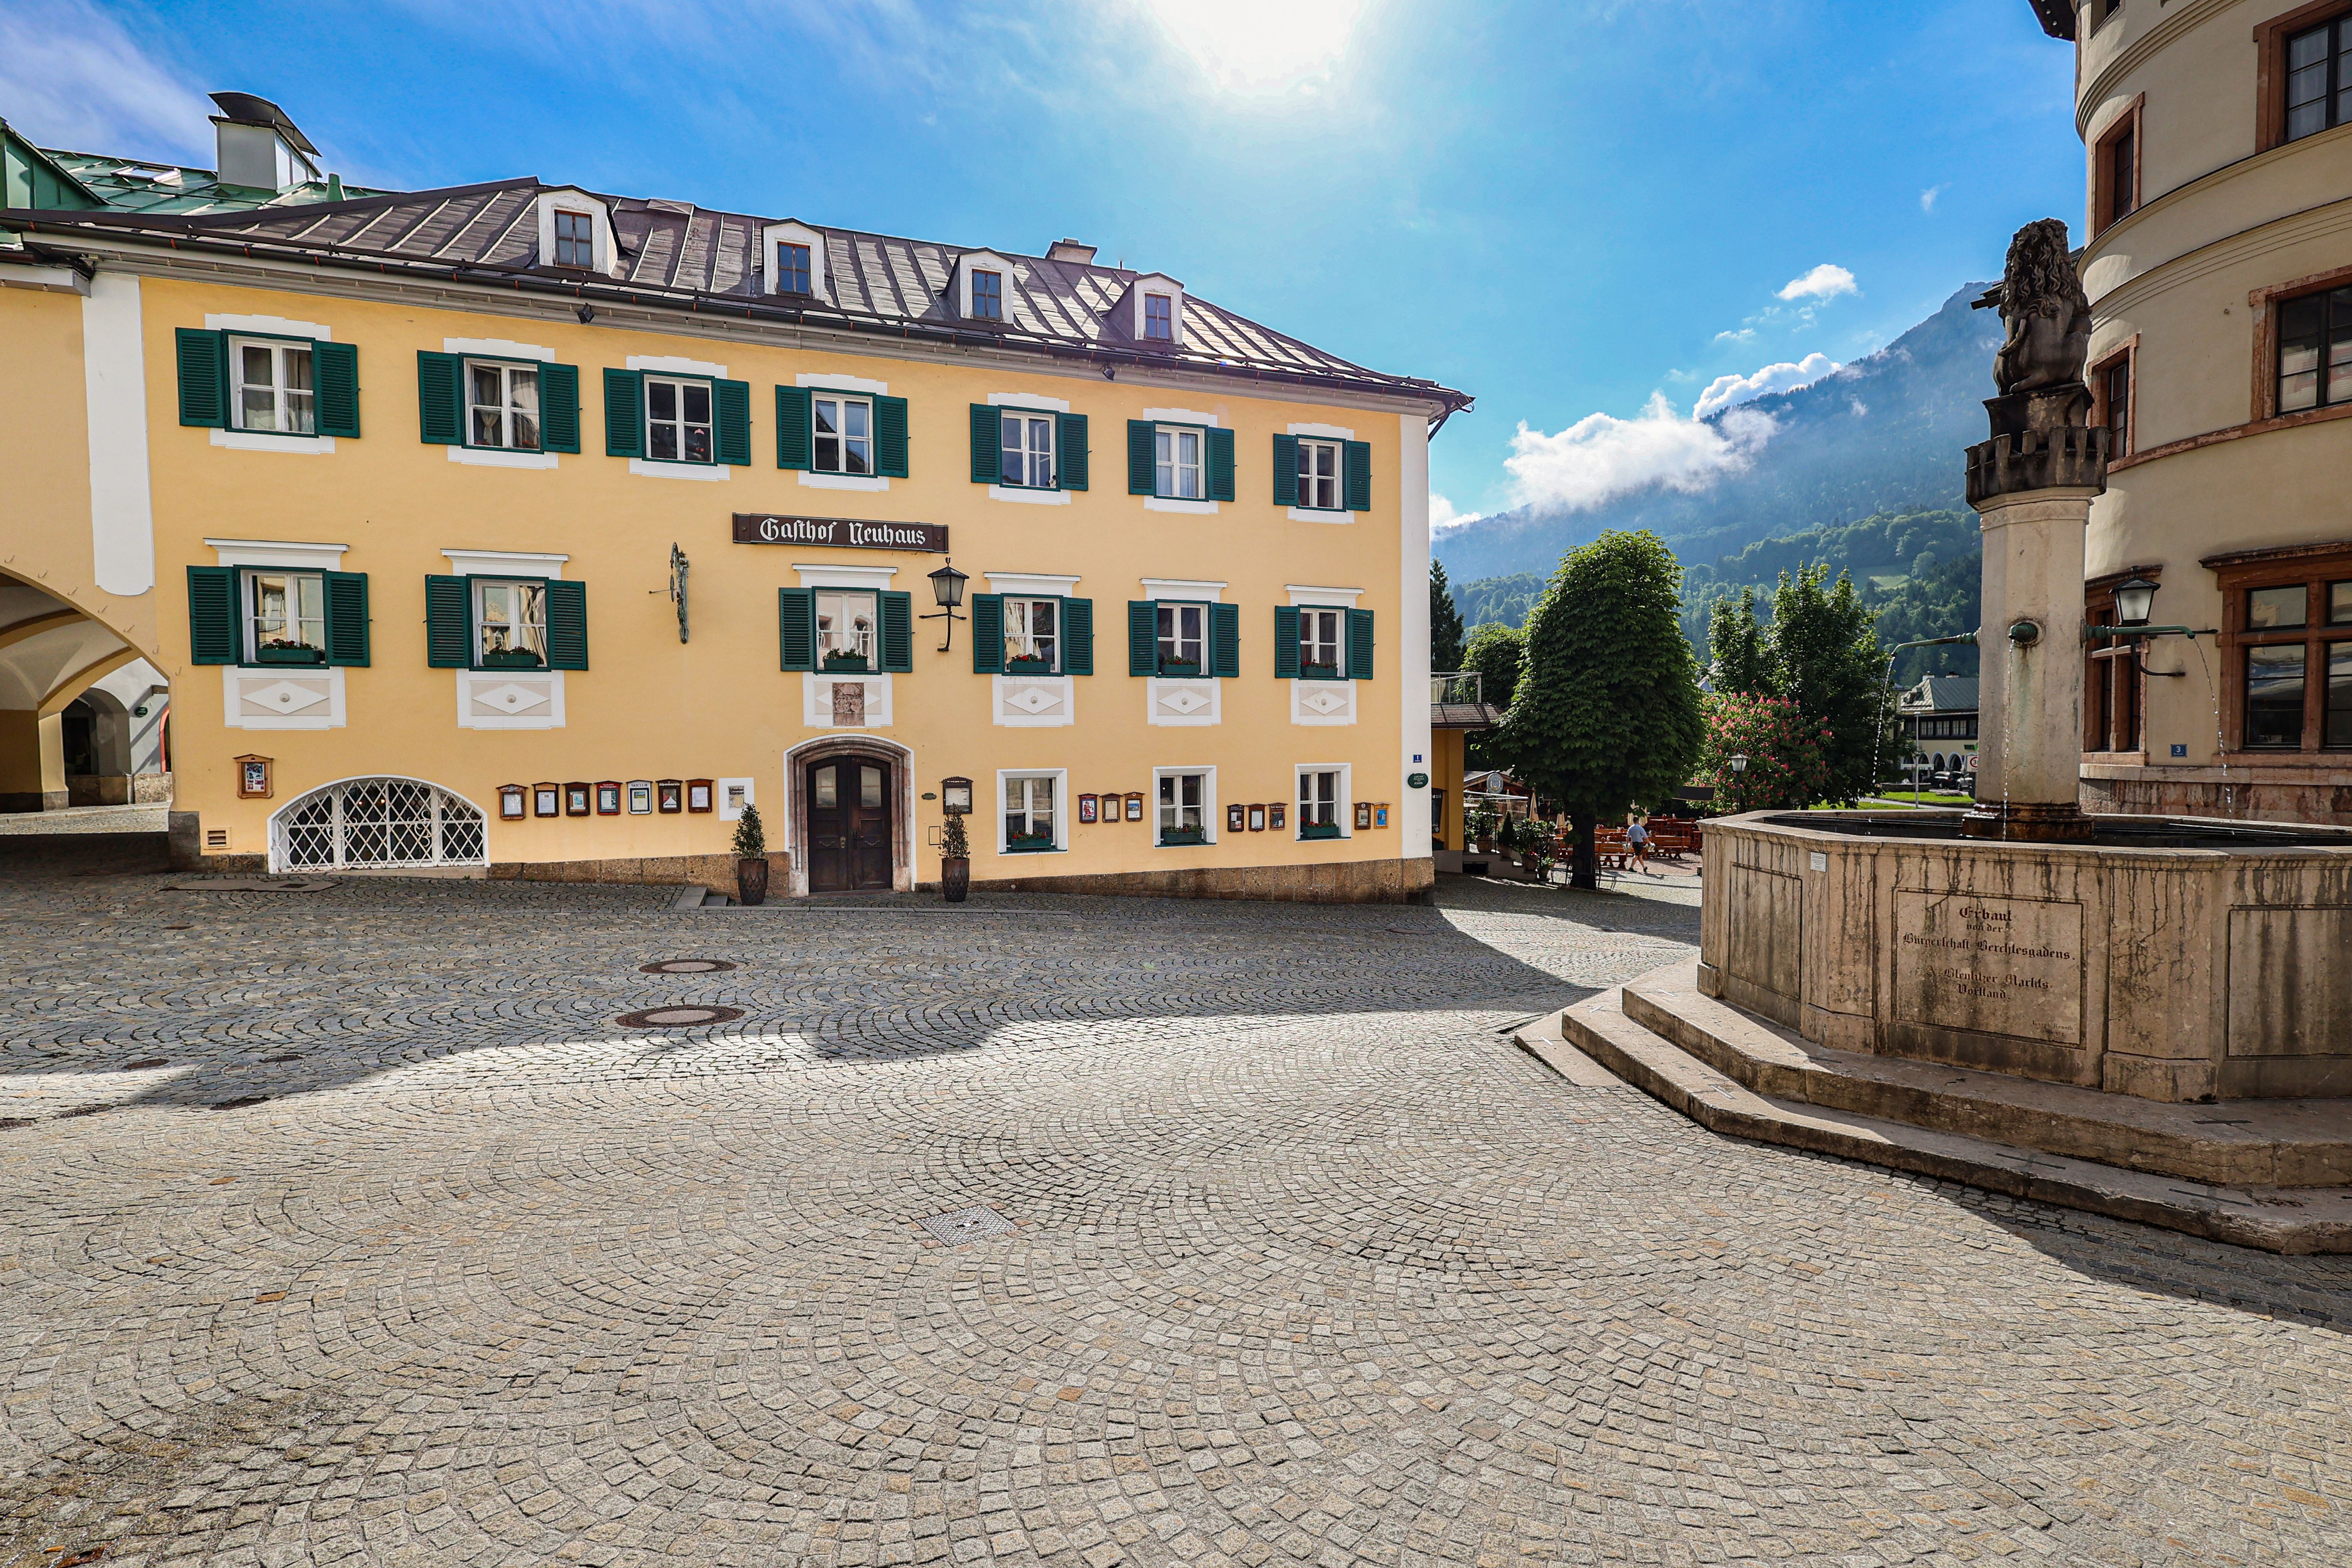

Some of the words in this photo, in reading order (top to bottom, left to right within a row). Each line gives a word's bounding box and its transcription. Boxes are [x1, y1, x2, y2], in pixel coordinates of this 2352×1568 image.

[760, 518, 838, 543] Gasthof
[848, 522, 925, 546] Neuhaus
[1960, 906, 2012, 921] Erbaut
[1987, 923, 2003, 932] der
